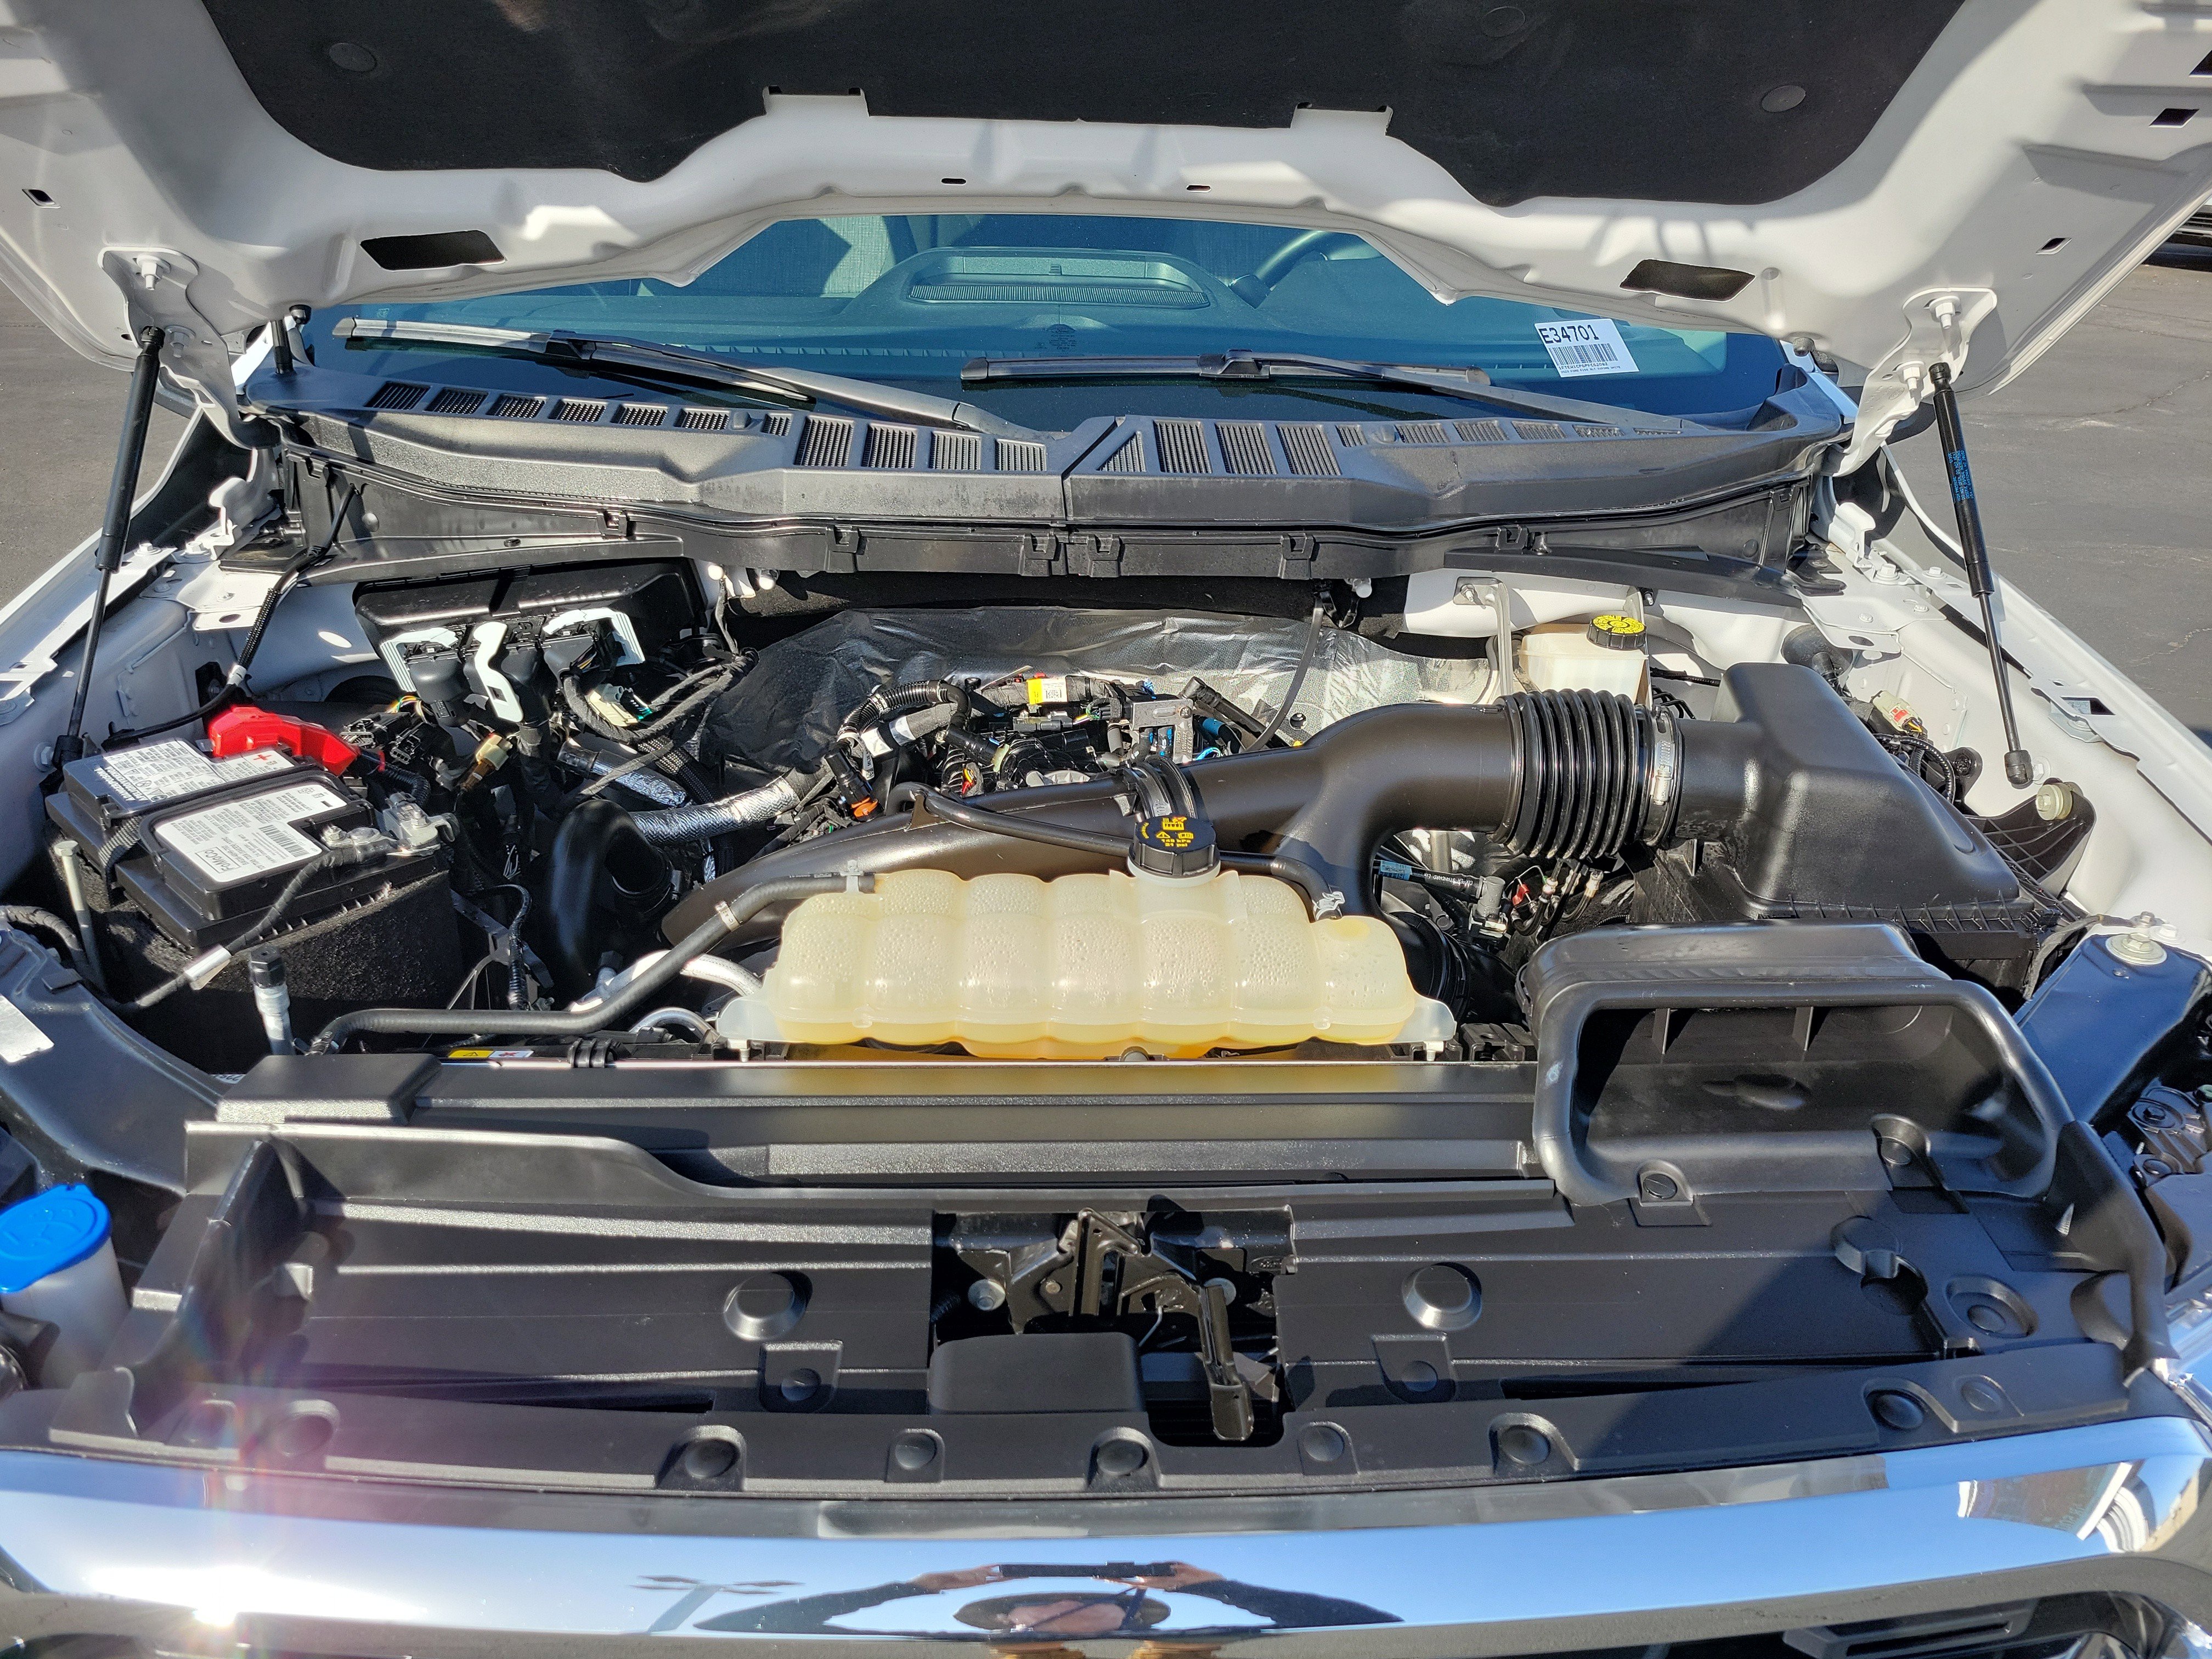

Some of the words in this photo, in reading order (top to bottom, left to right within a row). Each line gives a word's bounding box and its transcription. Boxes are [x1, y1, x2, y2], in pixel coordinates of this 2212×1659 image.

[1538, 325, 1599, 343] E34701
[205, 849, 234, 871] FoMoCo
[1433, 874, 1455, 883] STANDARD
